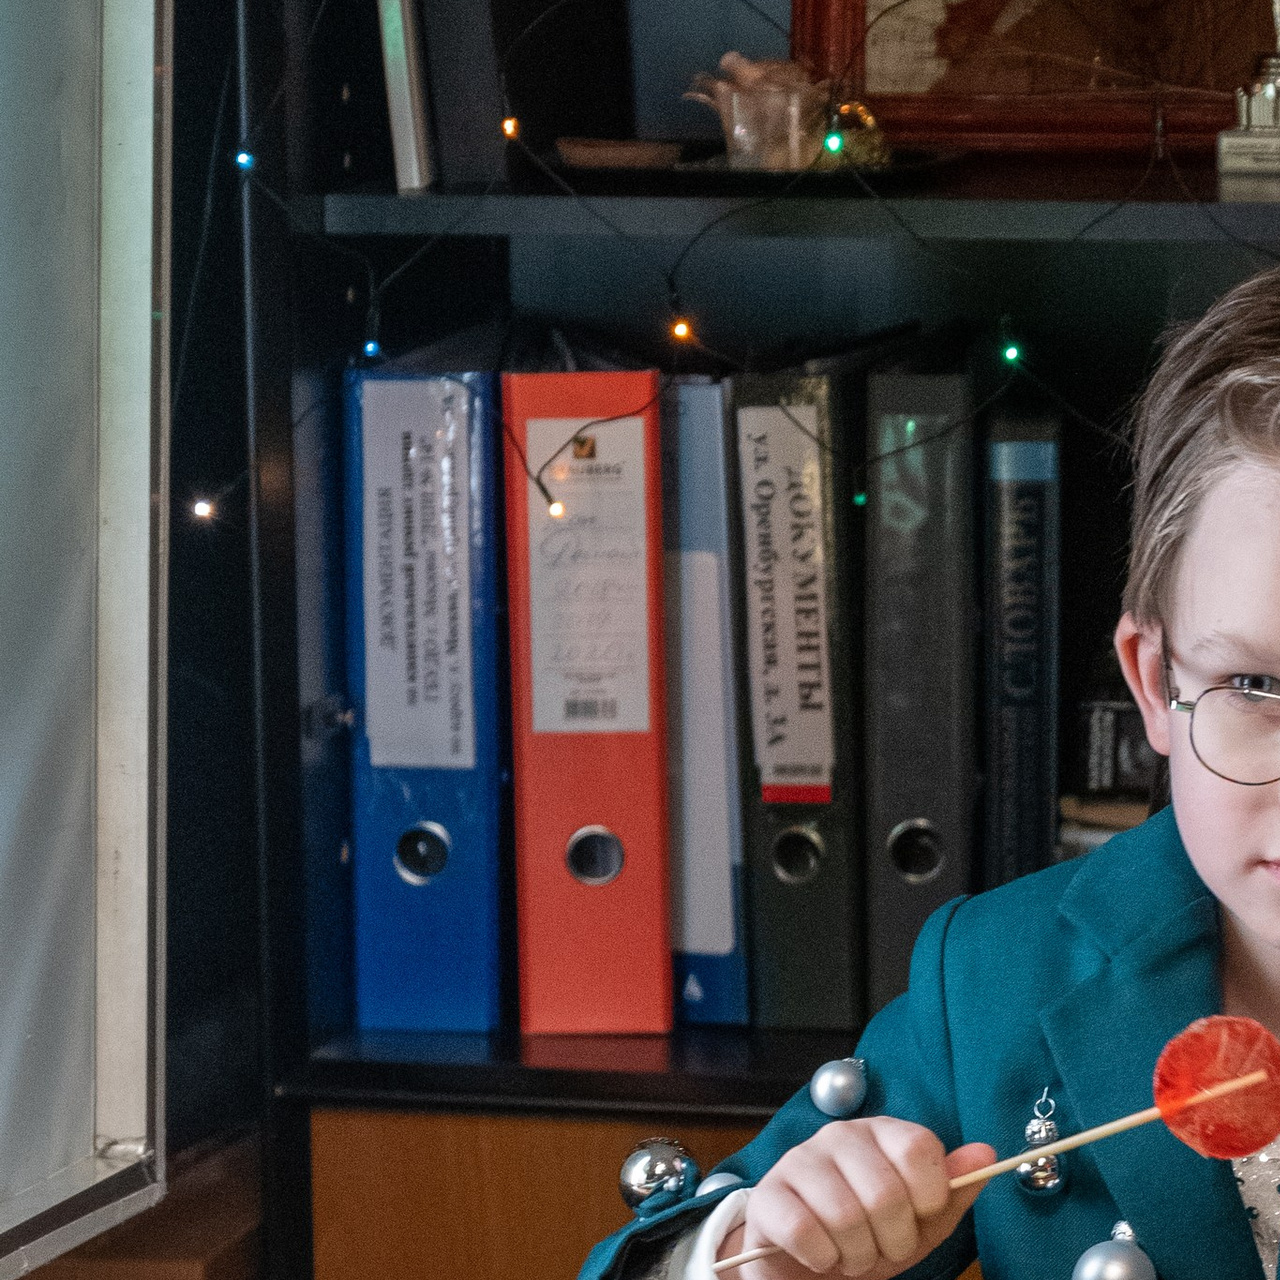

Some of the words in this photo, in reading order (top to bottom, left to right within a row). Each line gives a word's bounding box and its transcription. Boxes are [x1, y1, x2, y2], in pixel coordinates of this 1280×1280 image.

[747, 432, 771, 470] ул.
[752, 479, 785, 675] Оренбургская,
[786, 465, 825, 712] ДОКУМЕНТЫ
